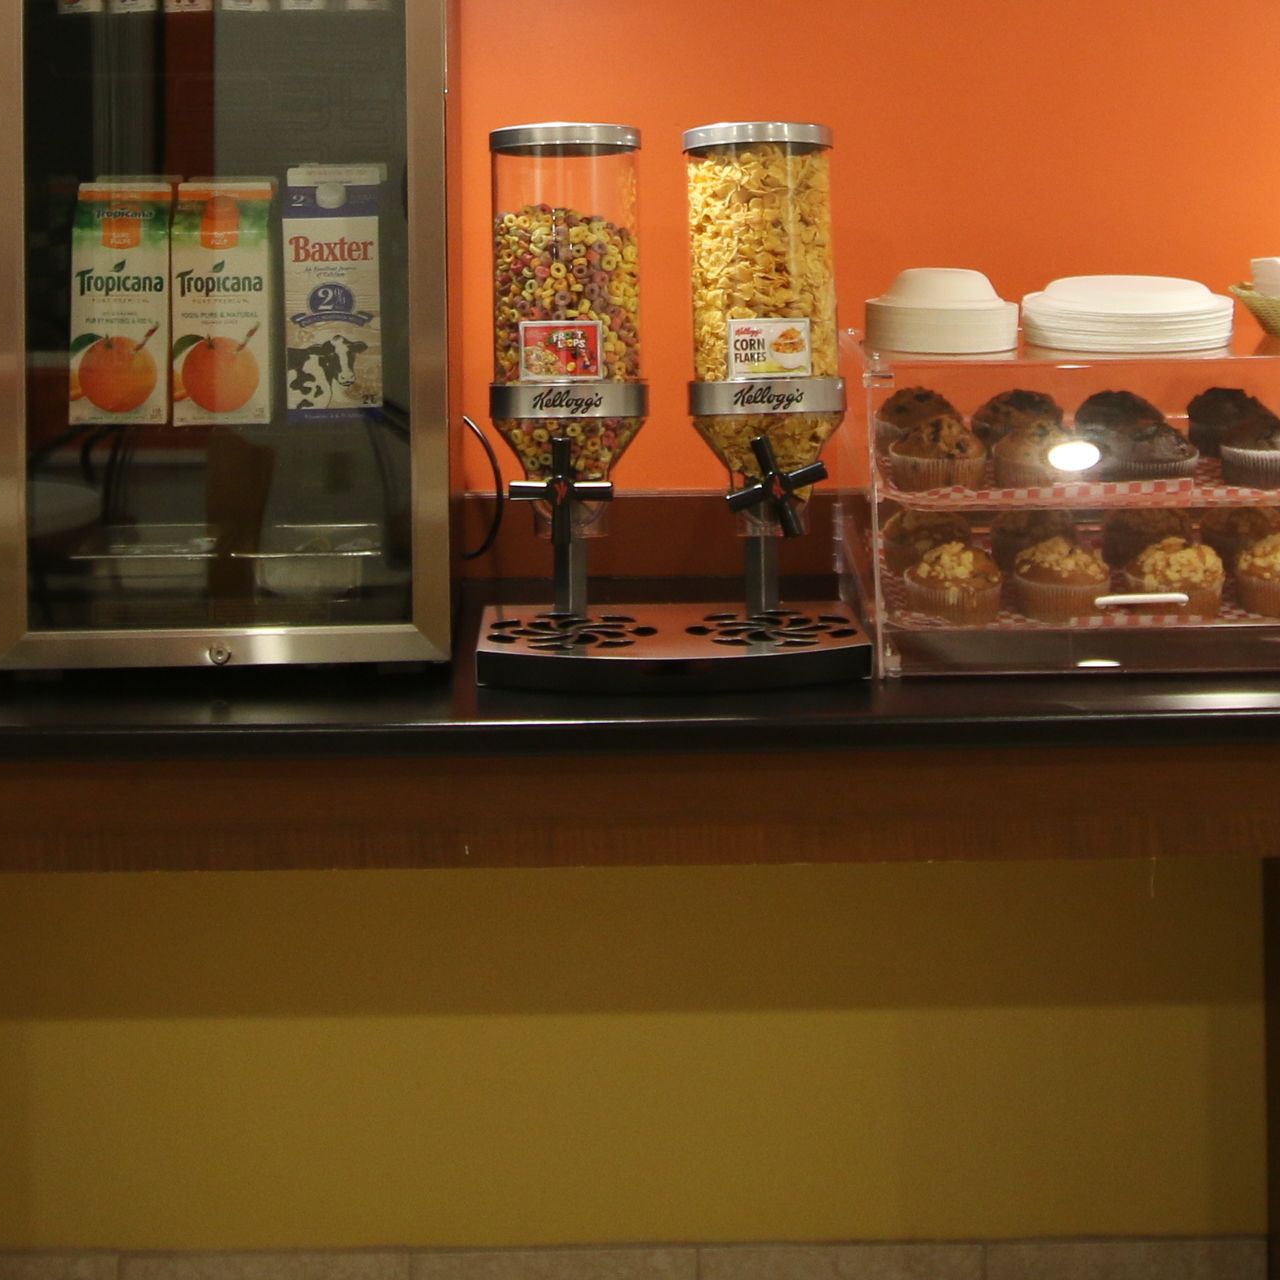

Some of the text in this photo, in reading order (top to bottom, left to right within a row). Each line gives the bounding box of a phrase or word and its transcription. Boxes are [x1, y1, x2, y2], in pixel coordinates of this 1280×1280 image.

[289, 236, 374, 263] Baxter
[75, 268, 164, 296] Tropicana
[176, 268, 263, 297] Tropicana
[318, 287, 346, 310] 2%
[734, 338, 766, 351] CORN
[734, 352, 767, 363] FLAKES
[532, 388, 603, 414] Kellogg's
[733, 384, 804, 410] Kellogg's
